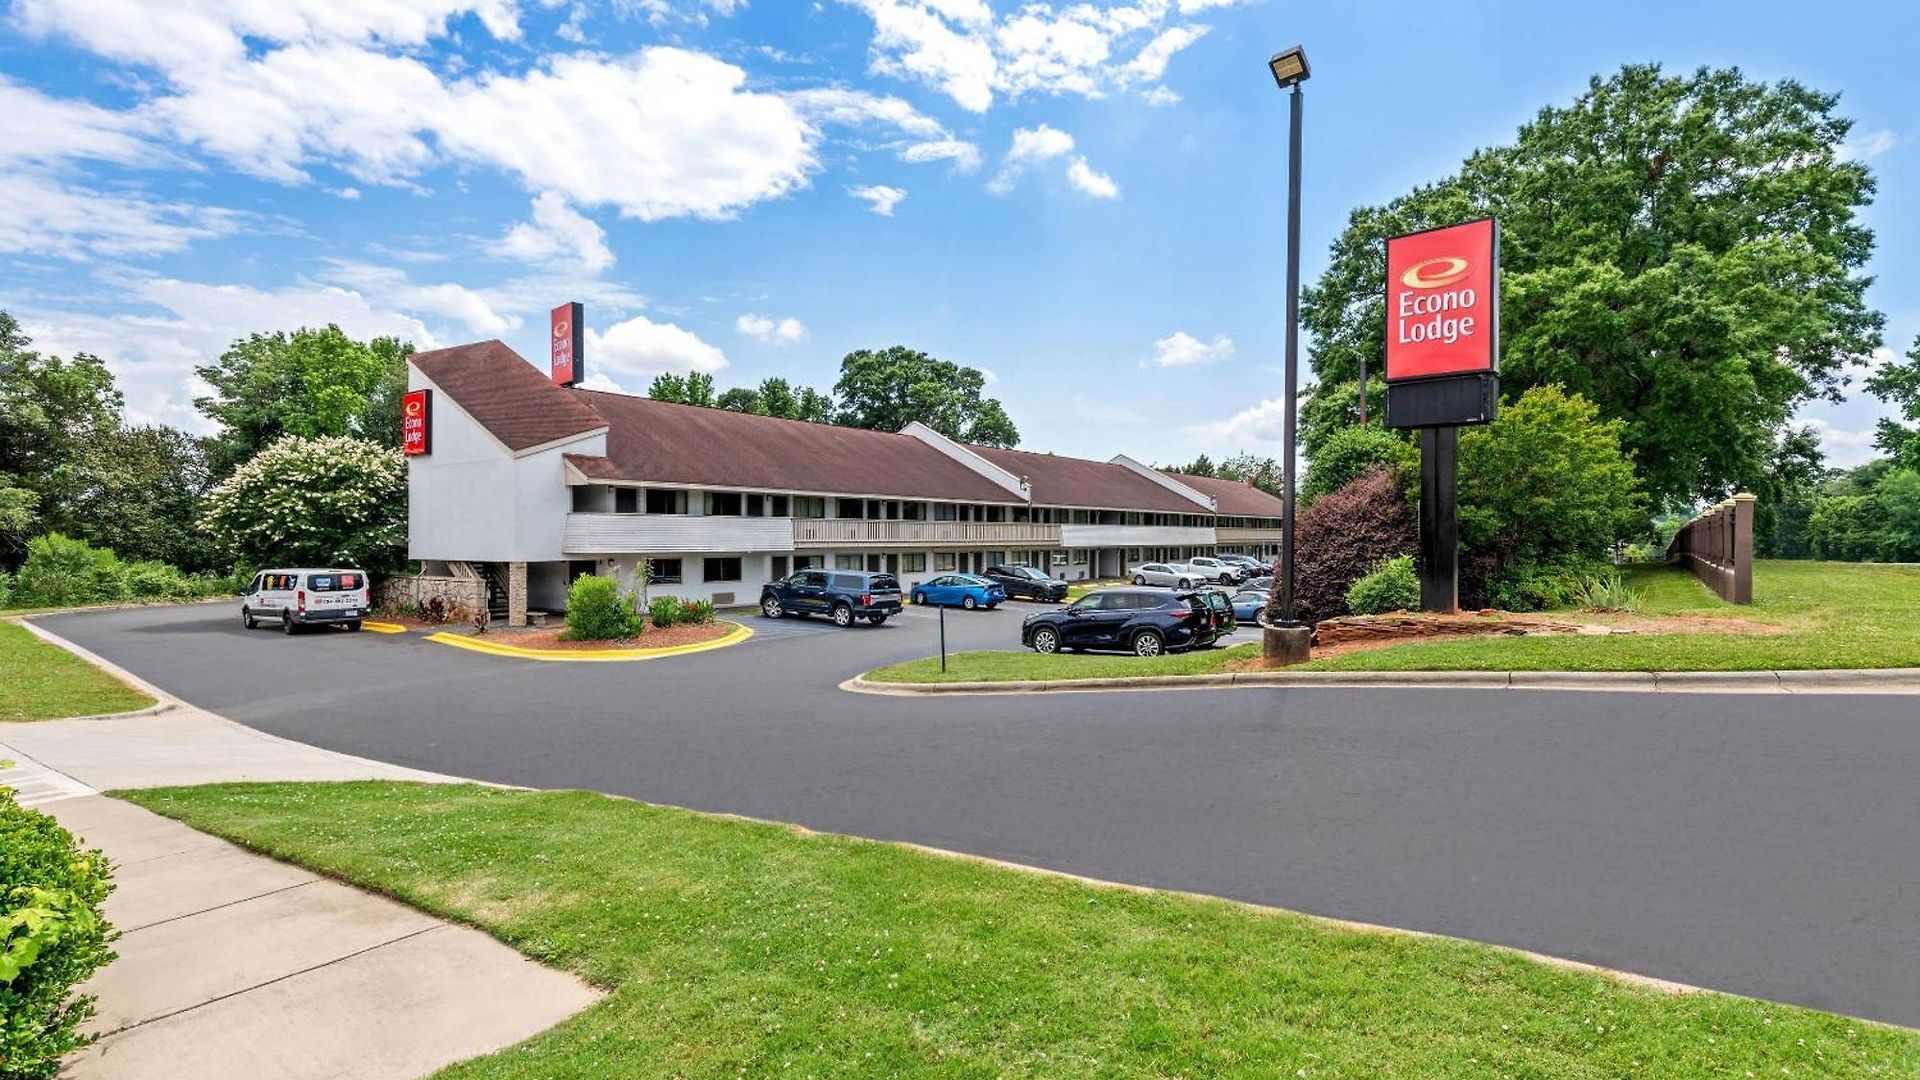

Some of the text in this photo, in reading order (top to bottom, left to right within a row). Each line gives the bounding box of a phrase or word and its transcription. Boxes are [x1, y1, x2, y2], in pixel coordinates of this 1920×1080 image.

[1400, 288, 1476, 317] Econo
[1400, 313, 1475, 344] Lodge
[405, 416, 422, 429] Econo
[405, 429, 422, 444] Lodge
